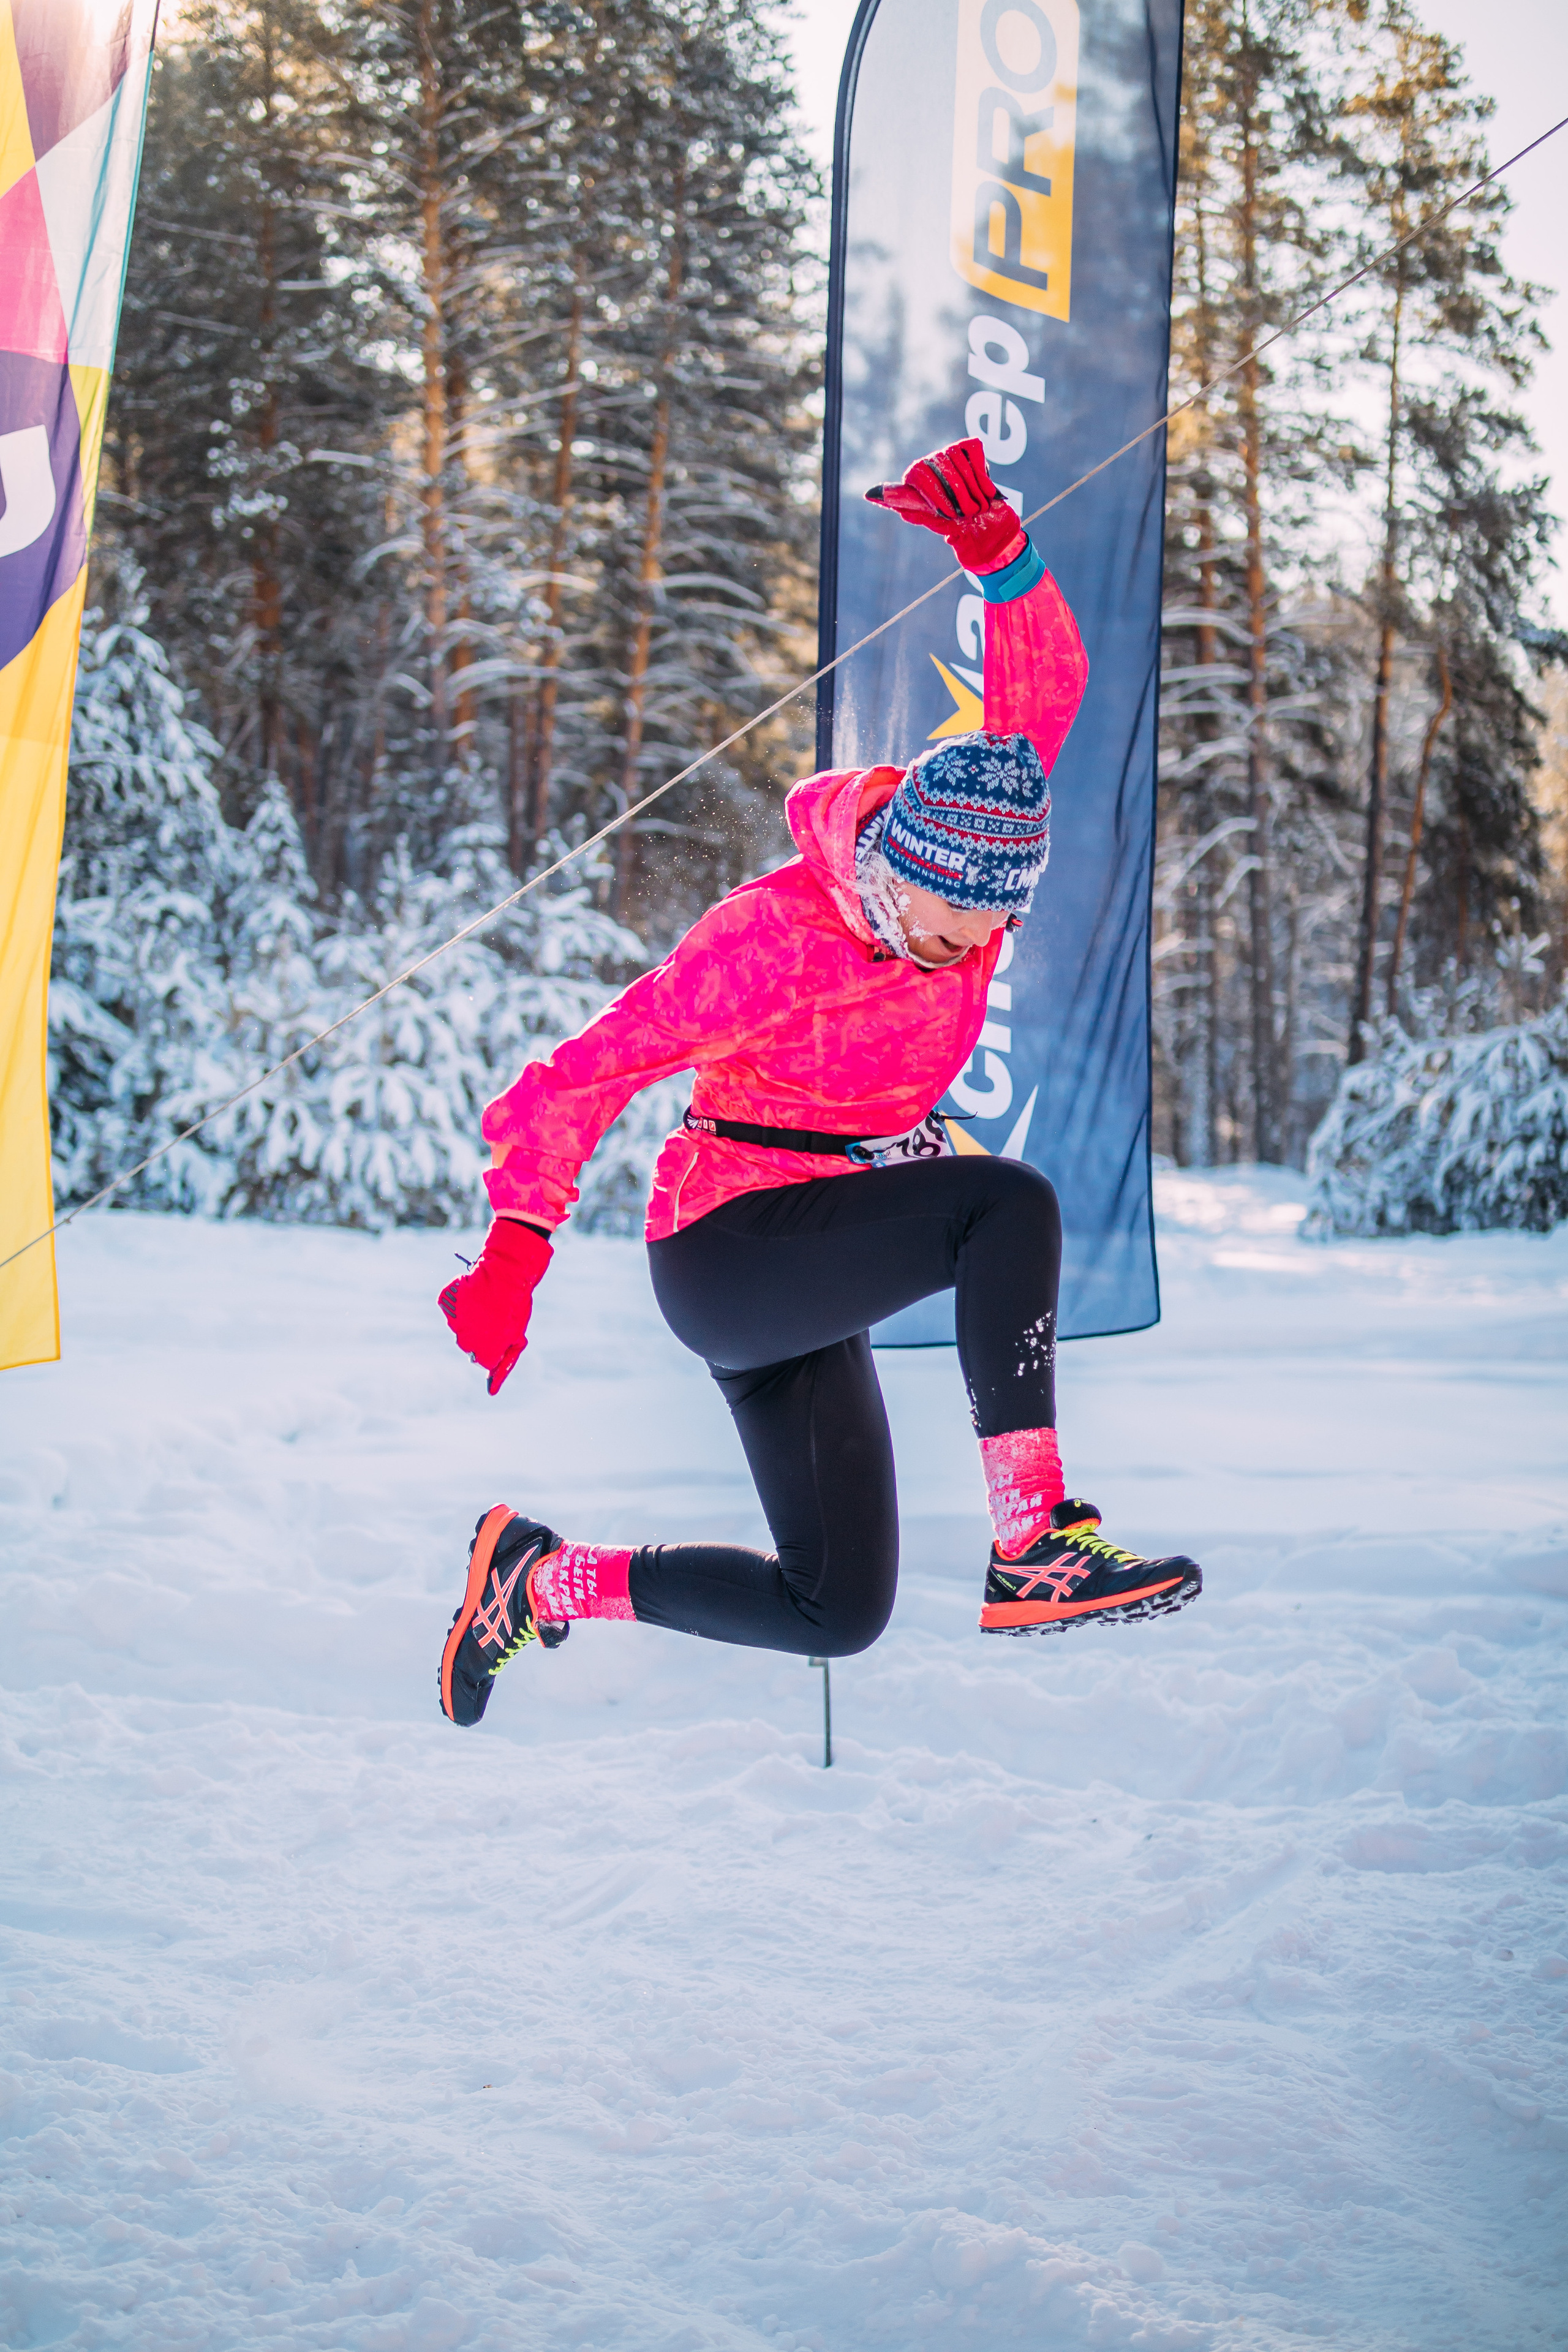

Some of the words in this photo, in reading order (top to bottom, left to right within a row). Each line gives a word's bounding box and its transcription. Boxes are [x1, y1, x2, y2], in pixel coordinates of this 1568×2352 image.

[973, 0, 1057, 291] PRO
[885, 844, 961, 888] EKATERINBURG
[891, 818, 966, 871] WINTER
[573, 1554, 586, 1600] БЕГИ
